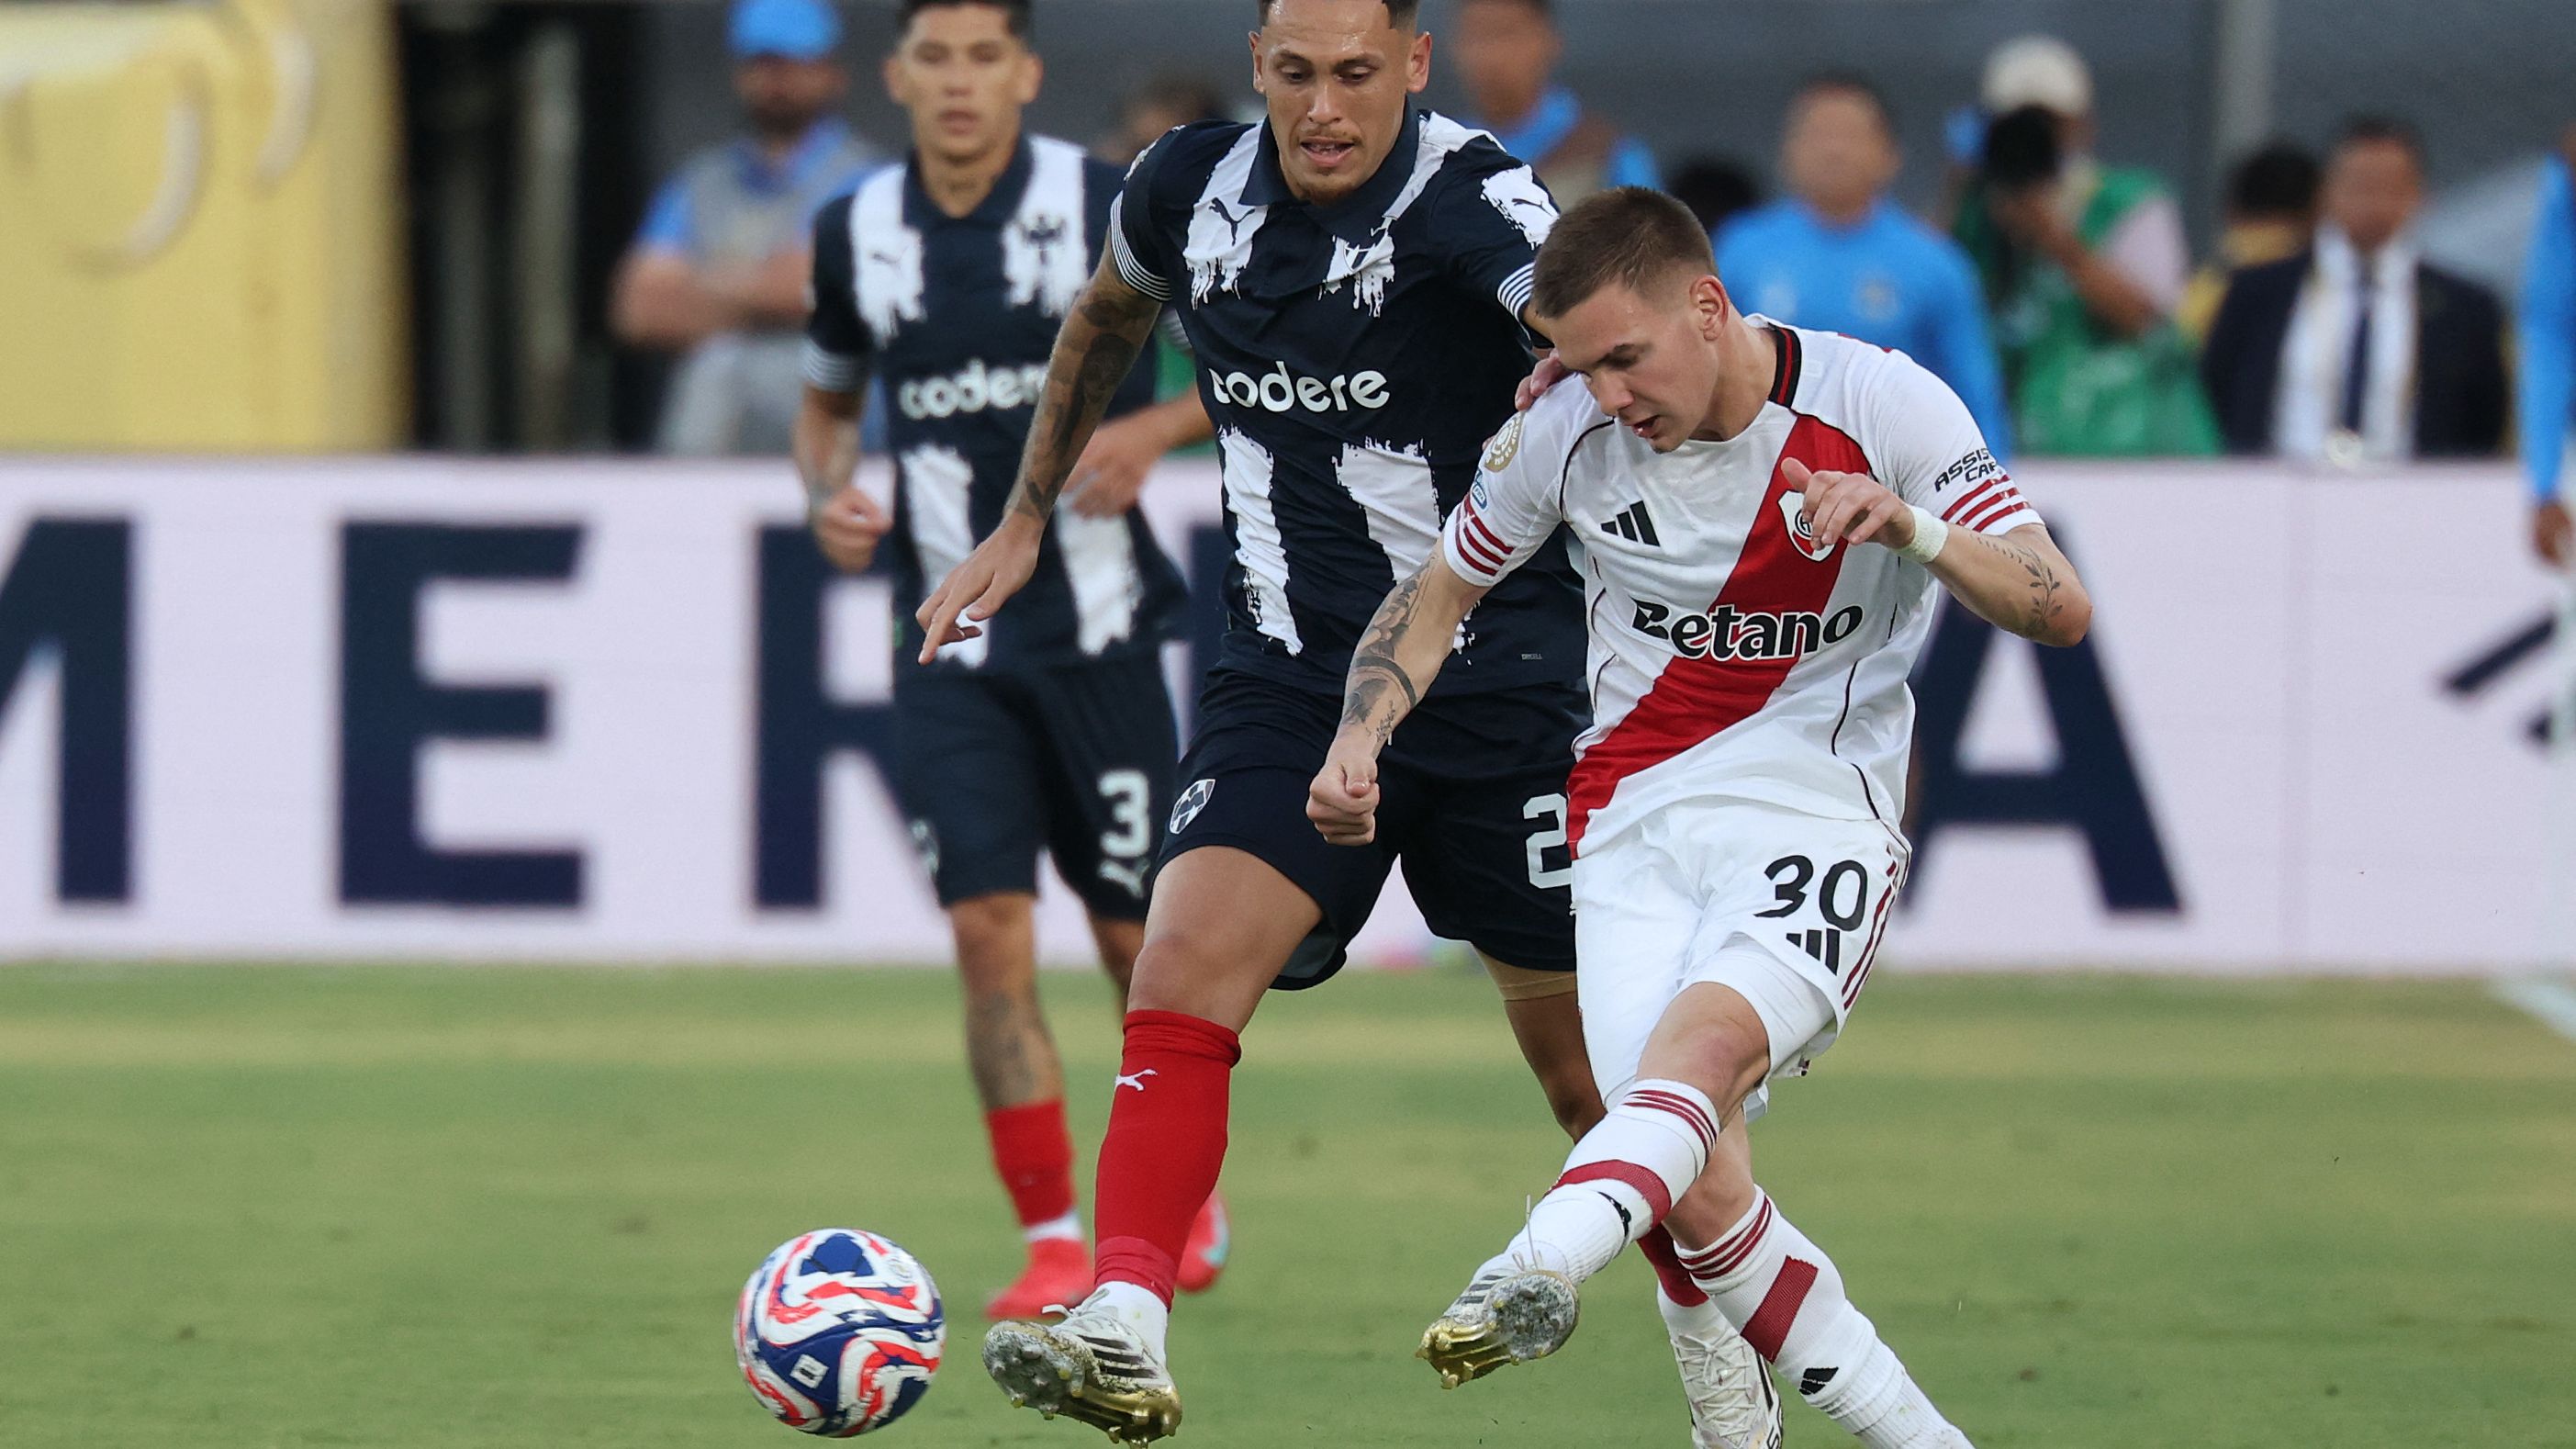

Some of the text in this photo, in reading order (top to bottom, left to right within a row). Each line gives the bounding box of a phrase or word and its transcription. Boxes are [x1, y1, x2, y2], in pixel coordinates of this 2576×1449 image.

[898, 359, 1049, 420] coder
[1630, 596, 1863, 661] Betano
[1098, 769, 1149, 858] 3
[1753, 855, 1867, 931] 30
